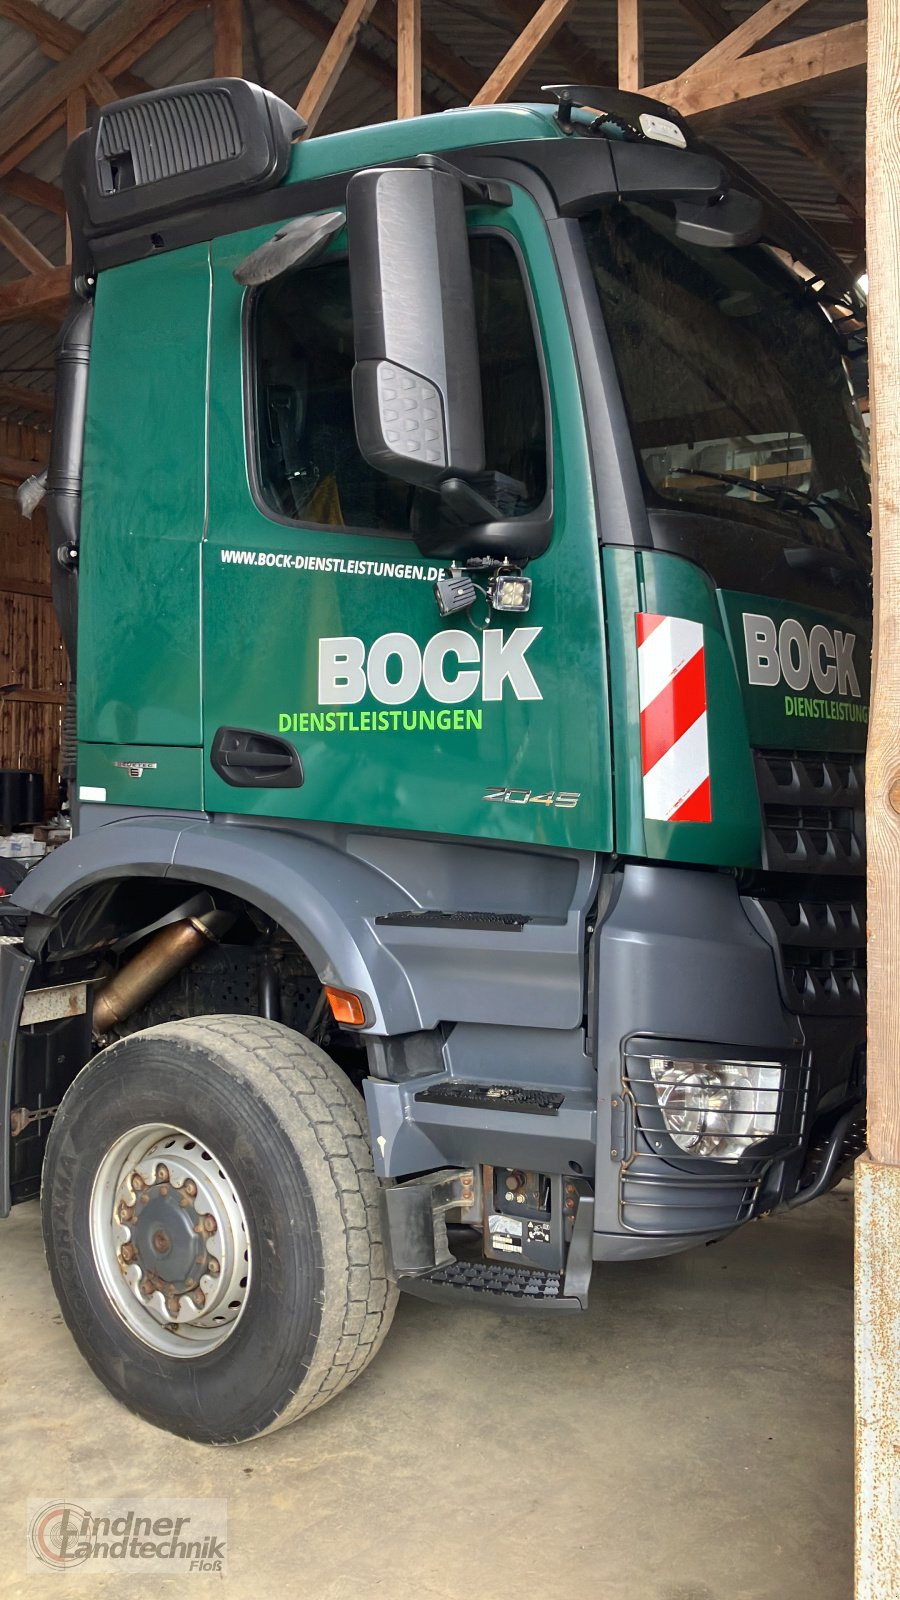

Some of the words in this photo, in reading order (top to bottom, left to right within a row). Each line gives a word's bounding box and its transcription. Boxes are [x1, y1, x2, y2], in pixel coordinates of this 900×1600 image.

[220, 549, 446, 582] WWW.BOCK-DIENSTLEISTUNGEN.DE
[318, 626, 544, 705] BOCK
[742, 612, 862, 698] BOCK
[278, 709, 483, 733] DIENSTLEISTUNGEN
[784, 695, 869, 724] DIENSTLEISTUNG
[482, 787, 581, 808] 2045
